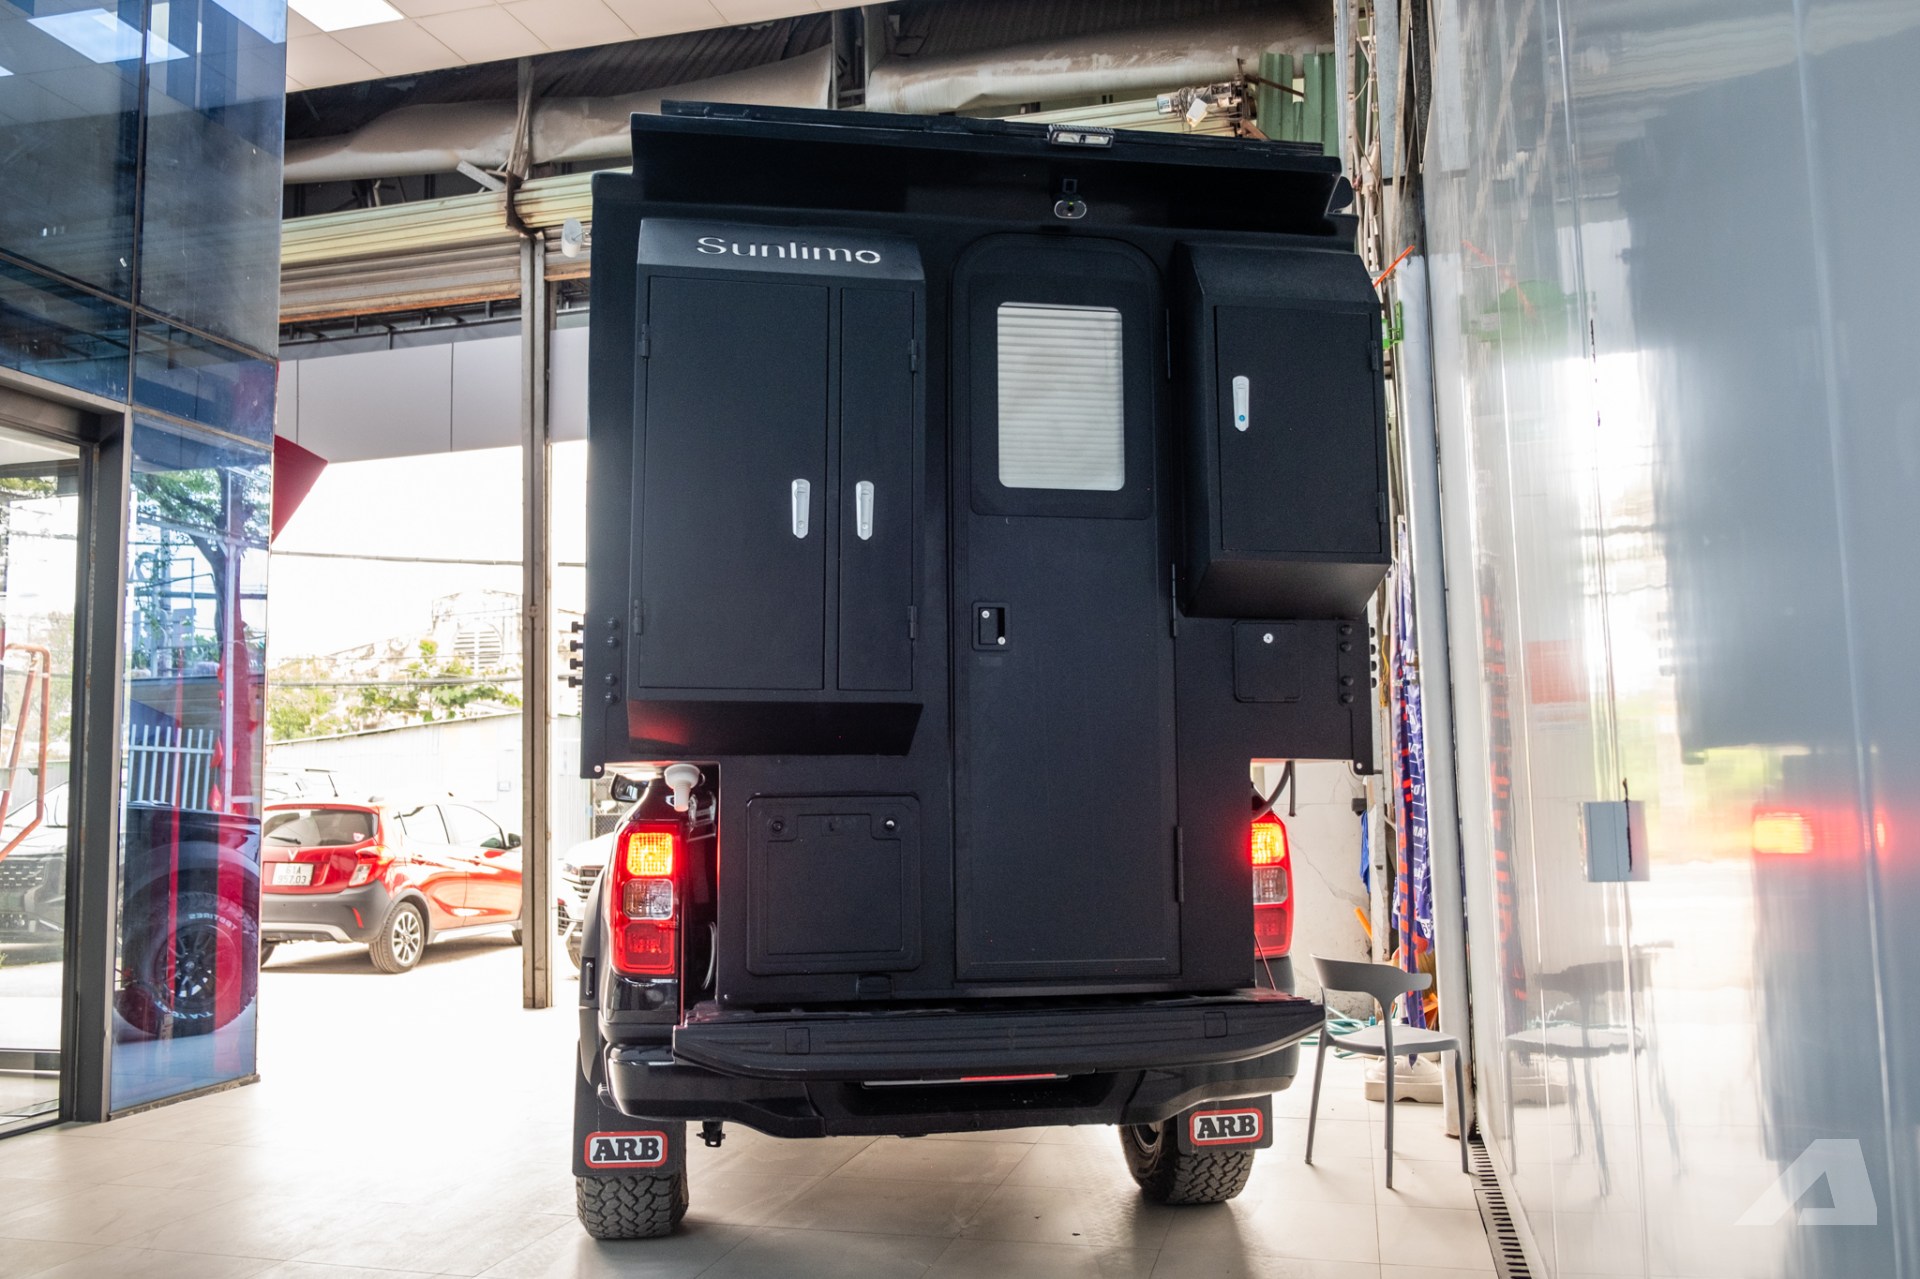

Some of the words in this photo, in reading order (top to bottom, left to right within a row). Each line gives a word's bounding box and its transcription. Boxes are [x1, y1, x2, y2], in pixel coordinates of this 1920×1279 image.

[696, 236, 881, 264] Sunlimo
[1197, 1114, 1256, 1139] ARB
[592, 1137, 660, 1162] ARB
